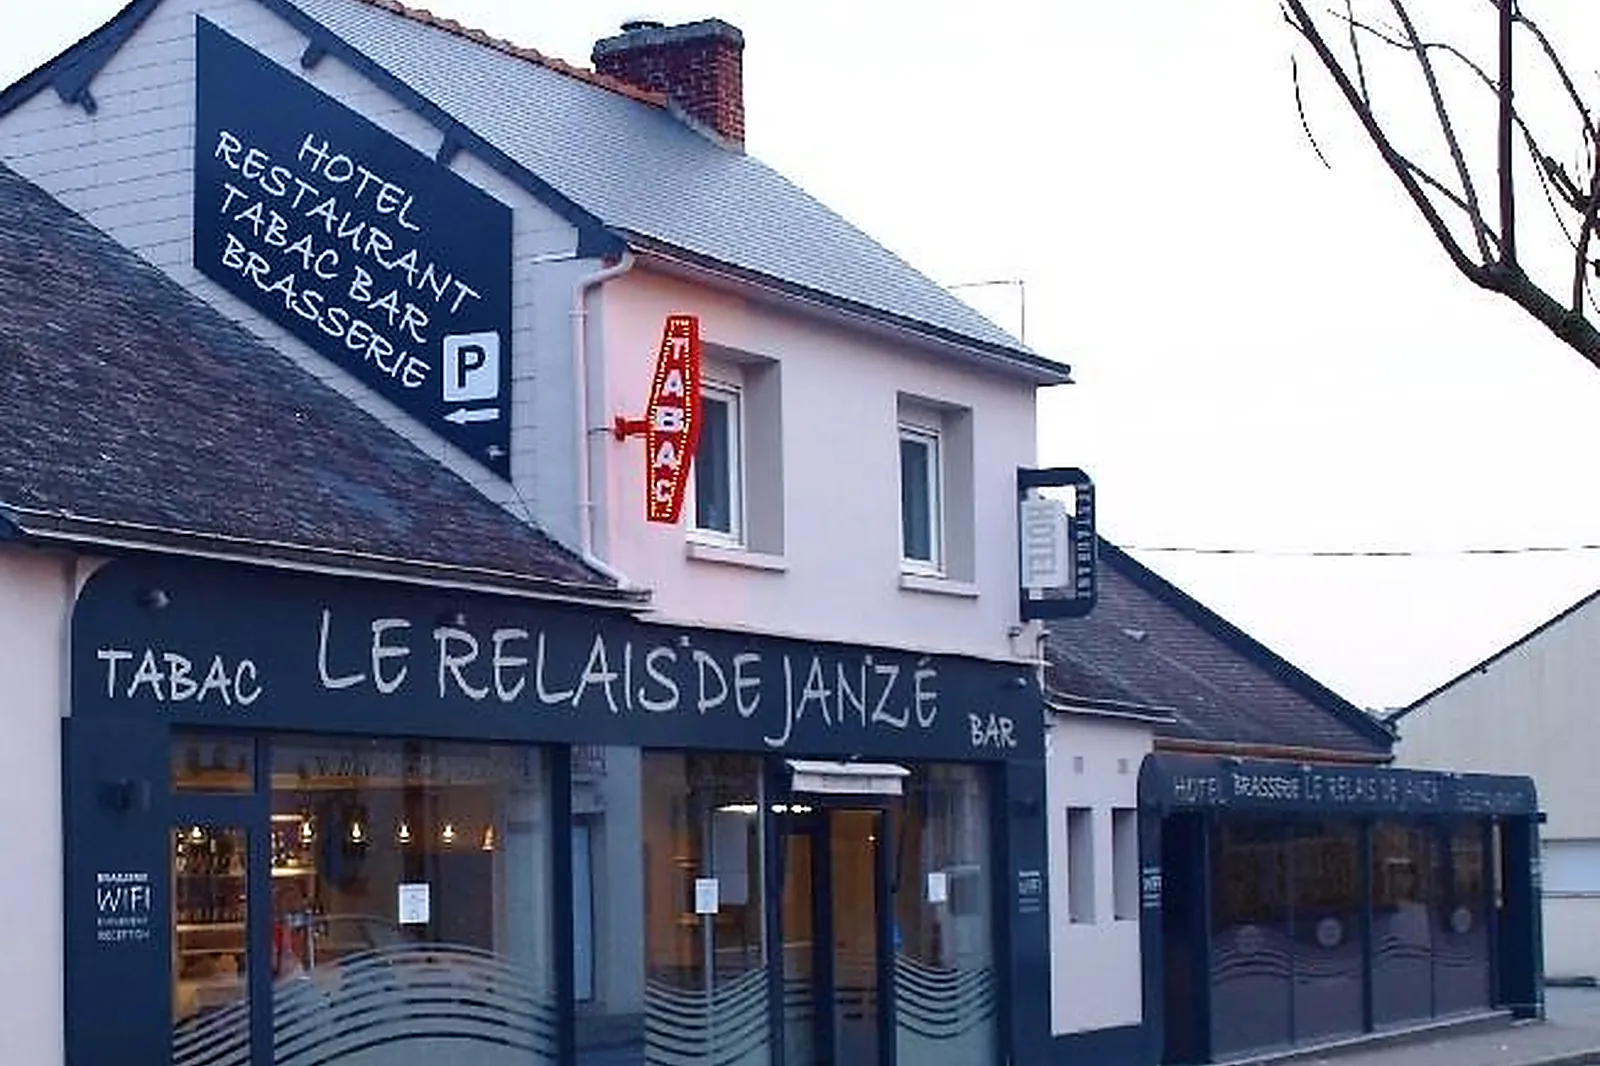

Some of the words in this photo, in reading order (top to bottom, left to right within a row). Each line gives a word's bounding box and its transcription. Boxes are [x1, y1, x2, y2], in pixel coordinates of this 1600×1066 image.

[214, 131, 482, 314] RESTAURANT
[298, 133, 420, 232] HOTEL
[221, 183, 339, 279] TABAC
[350, 265, 428, 343] BAR
[221, 233, 432, 389] BRASSERIE
[456, 345, 487, 389] P
[653, 336, 685, 503] TABAC
[97, 648, 263, 706] TABAC
[317, 608, 411, 694] LE
[433, 626, 678, 715] RELAIS
[694, 650, 762, 718] DE
[764, 654, 939, 748] JANZÉ
[968, 713, 1017, 748] BAR
[97, 885, 150, 912] WIFI
